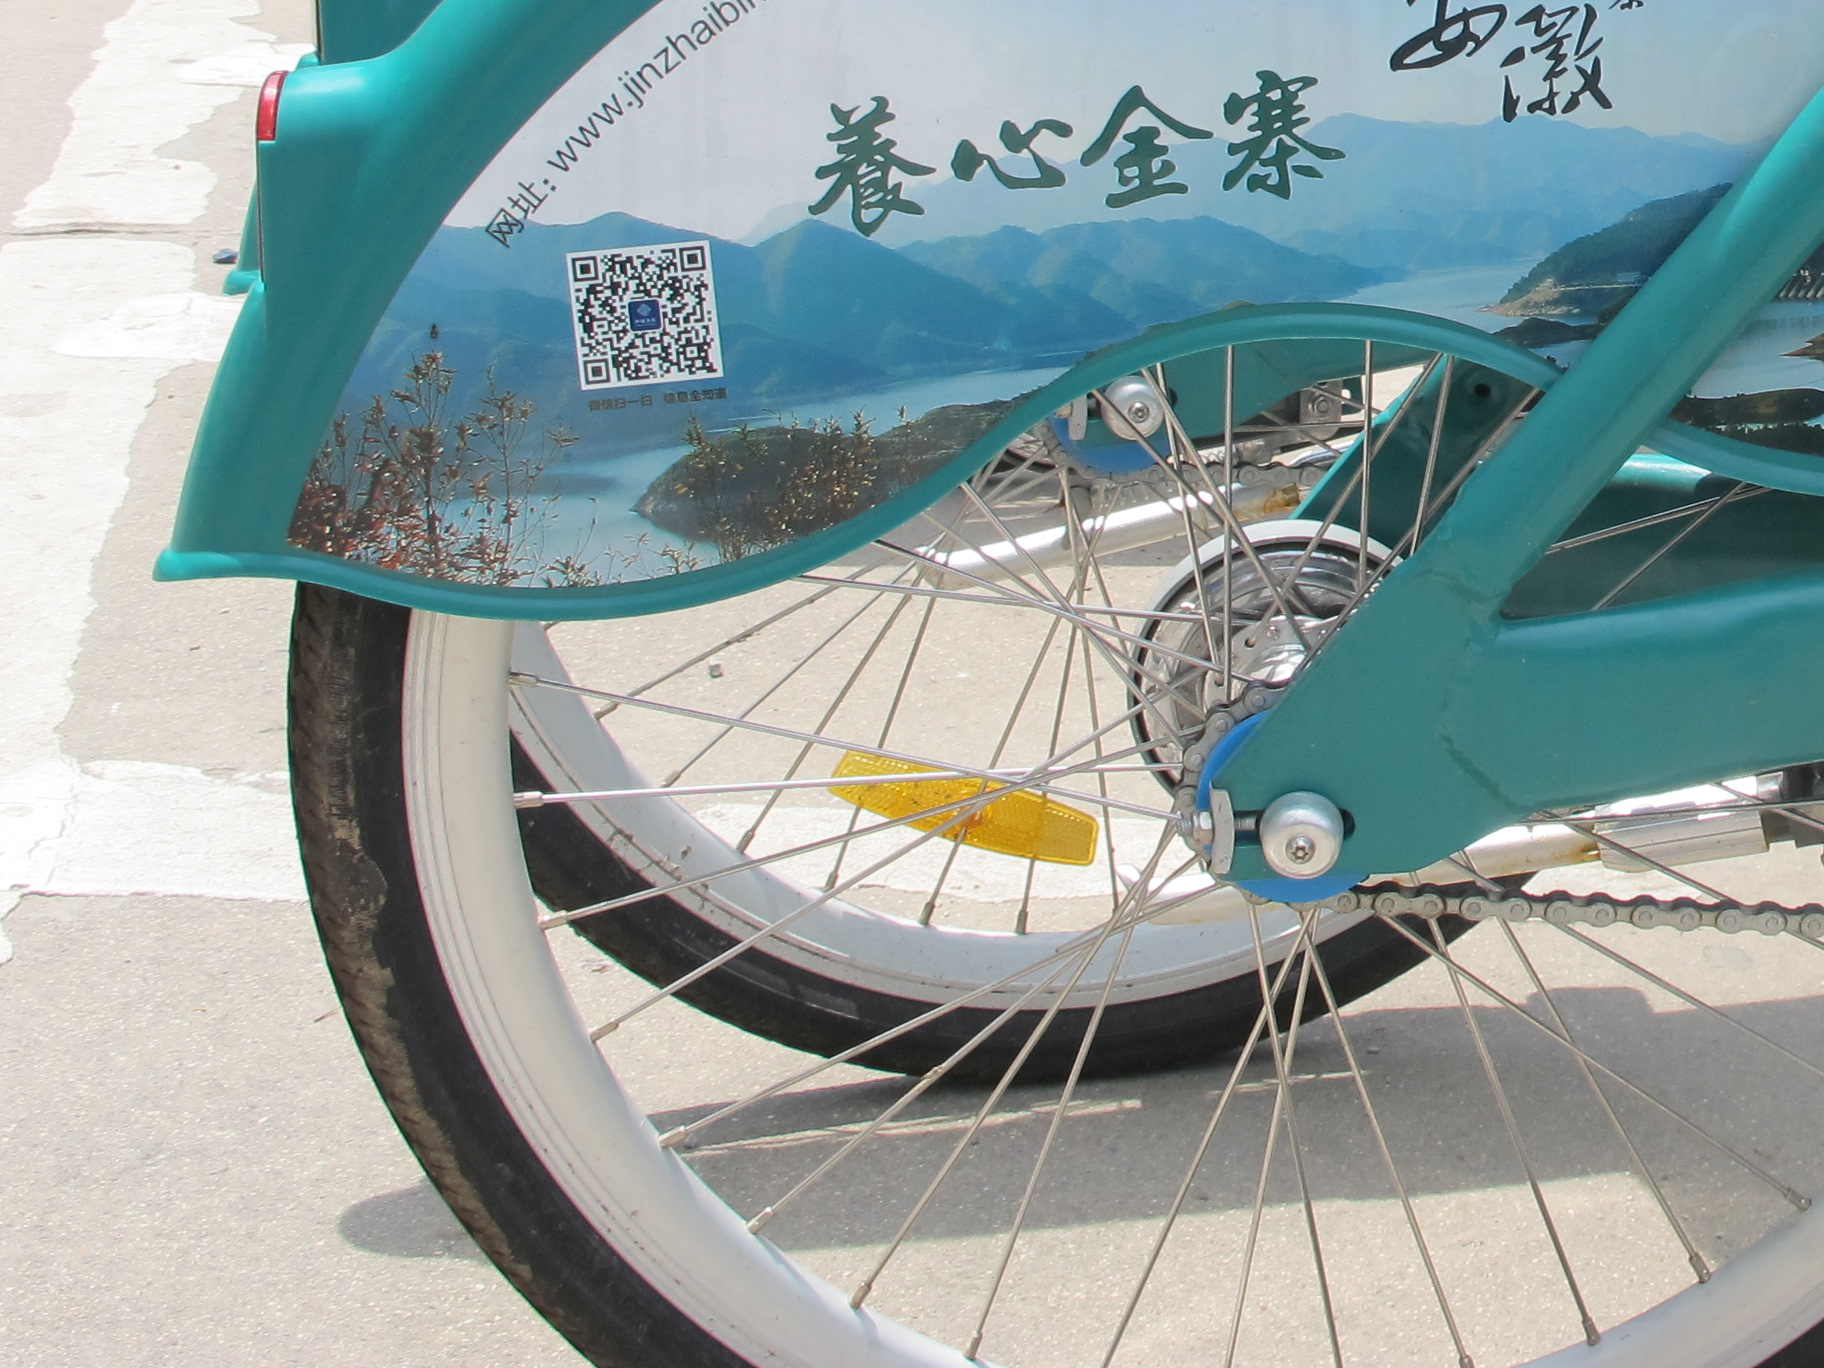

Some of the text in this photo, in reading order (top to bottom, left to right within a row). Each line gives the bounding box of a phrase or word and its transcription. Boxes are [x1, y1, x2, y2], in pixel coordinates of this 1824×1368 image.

[486, 175, 557, 248] 网址:
[807, 69, 1347, 238] 養心金寨
